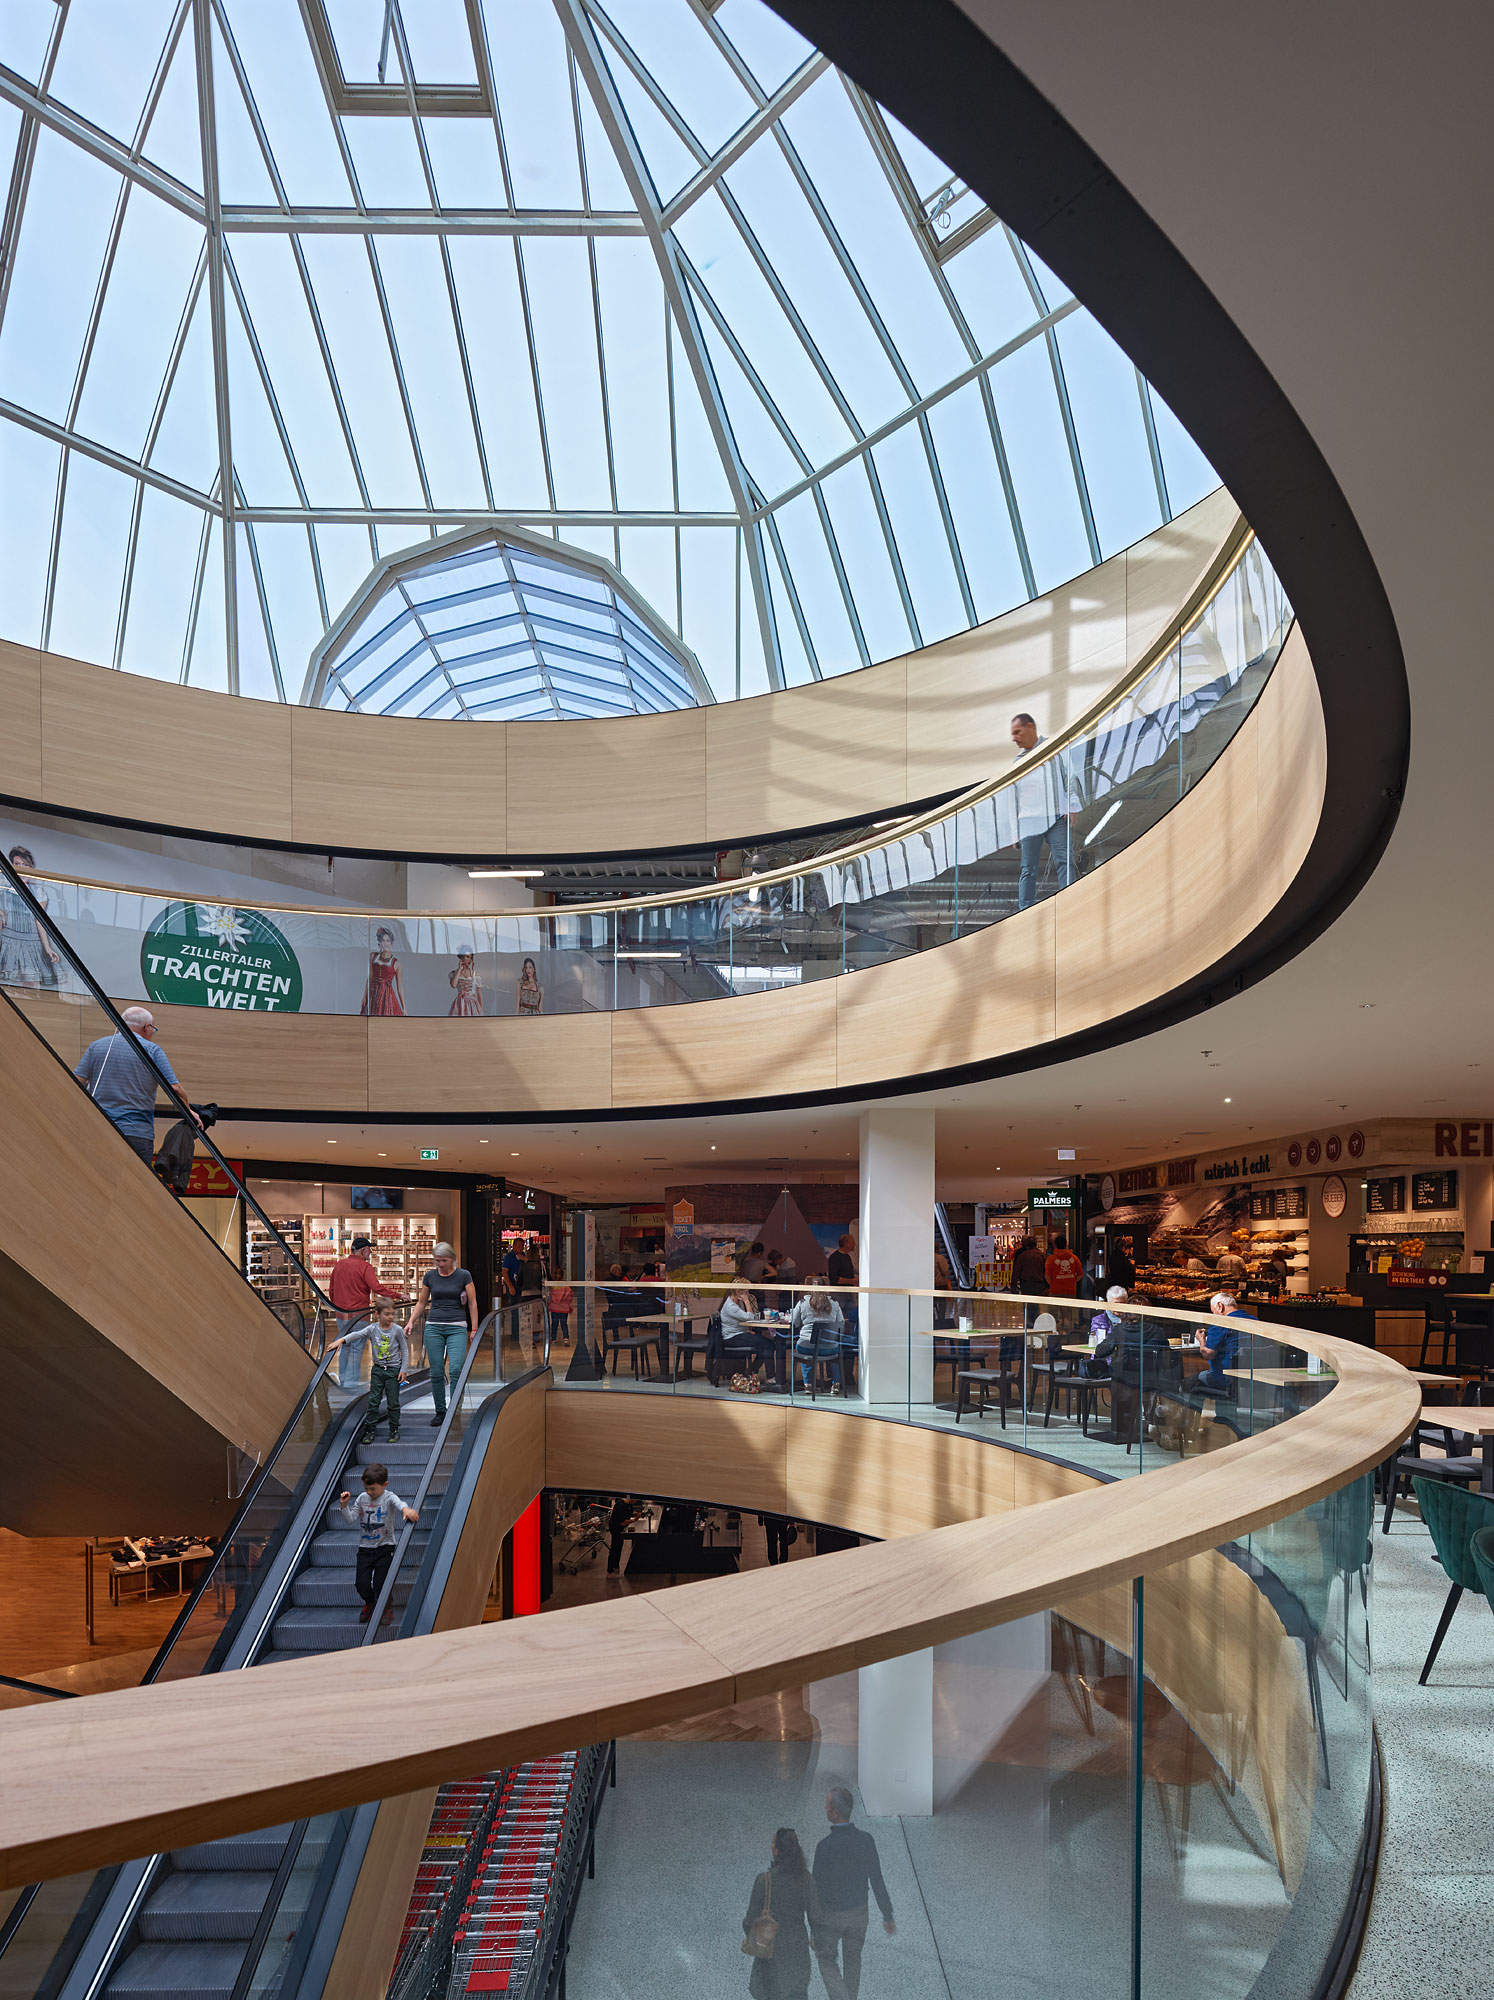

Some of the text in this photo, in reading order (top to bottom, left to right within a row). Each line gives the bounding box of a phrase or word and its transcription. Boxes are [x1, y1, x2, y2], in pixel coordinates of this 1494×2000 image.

[180, 944, 272, 969] ZILLERTALER
[147, 953, 292, 995] TRACHTEN
[206, 987, 280, 1012] WELT
[1435, 1123, 1493, 1157] REI
[1167, 1158, 1197, 1186] BROT
[1204, 1159, 1239, 1181] natürlich
[1249, 1154, 1271, 1175] echt
[1033, 1197, 1071, 1205] PALMERS
[674, 1215, 692, 1223] TICKET
[674, 1225, 689, 1233] TIROL
